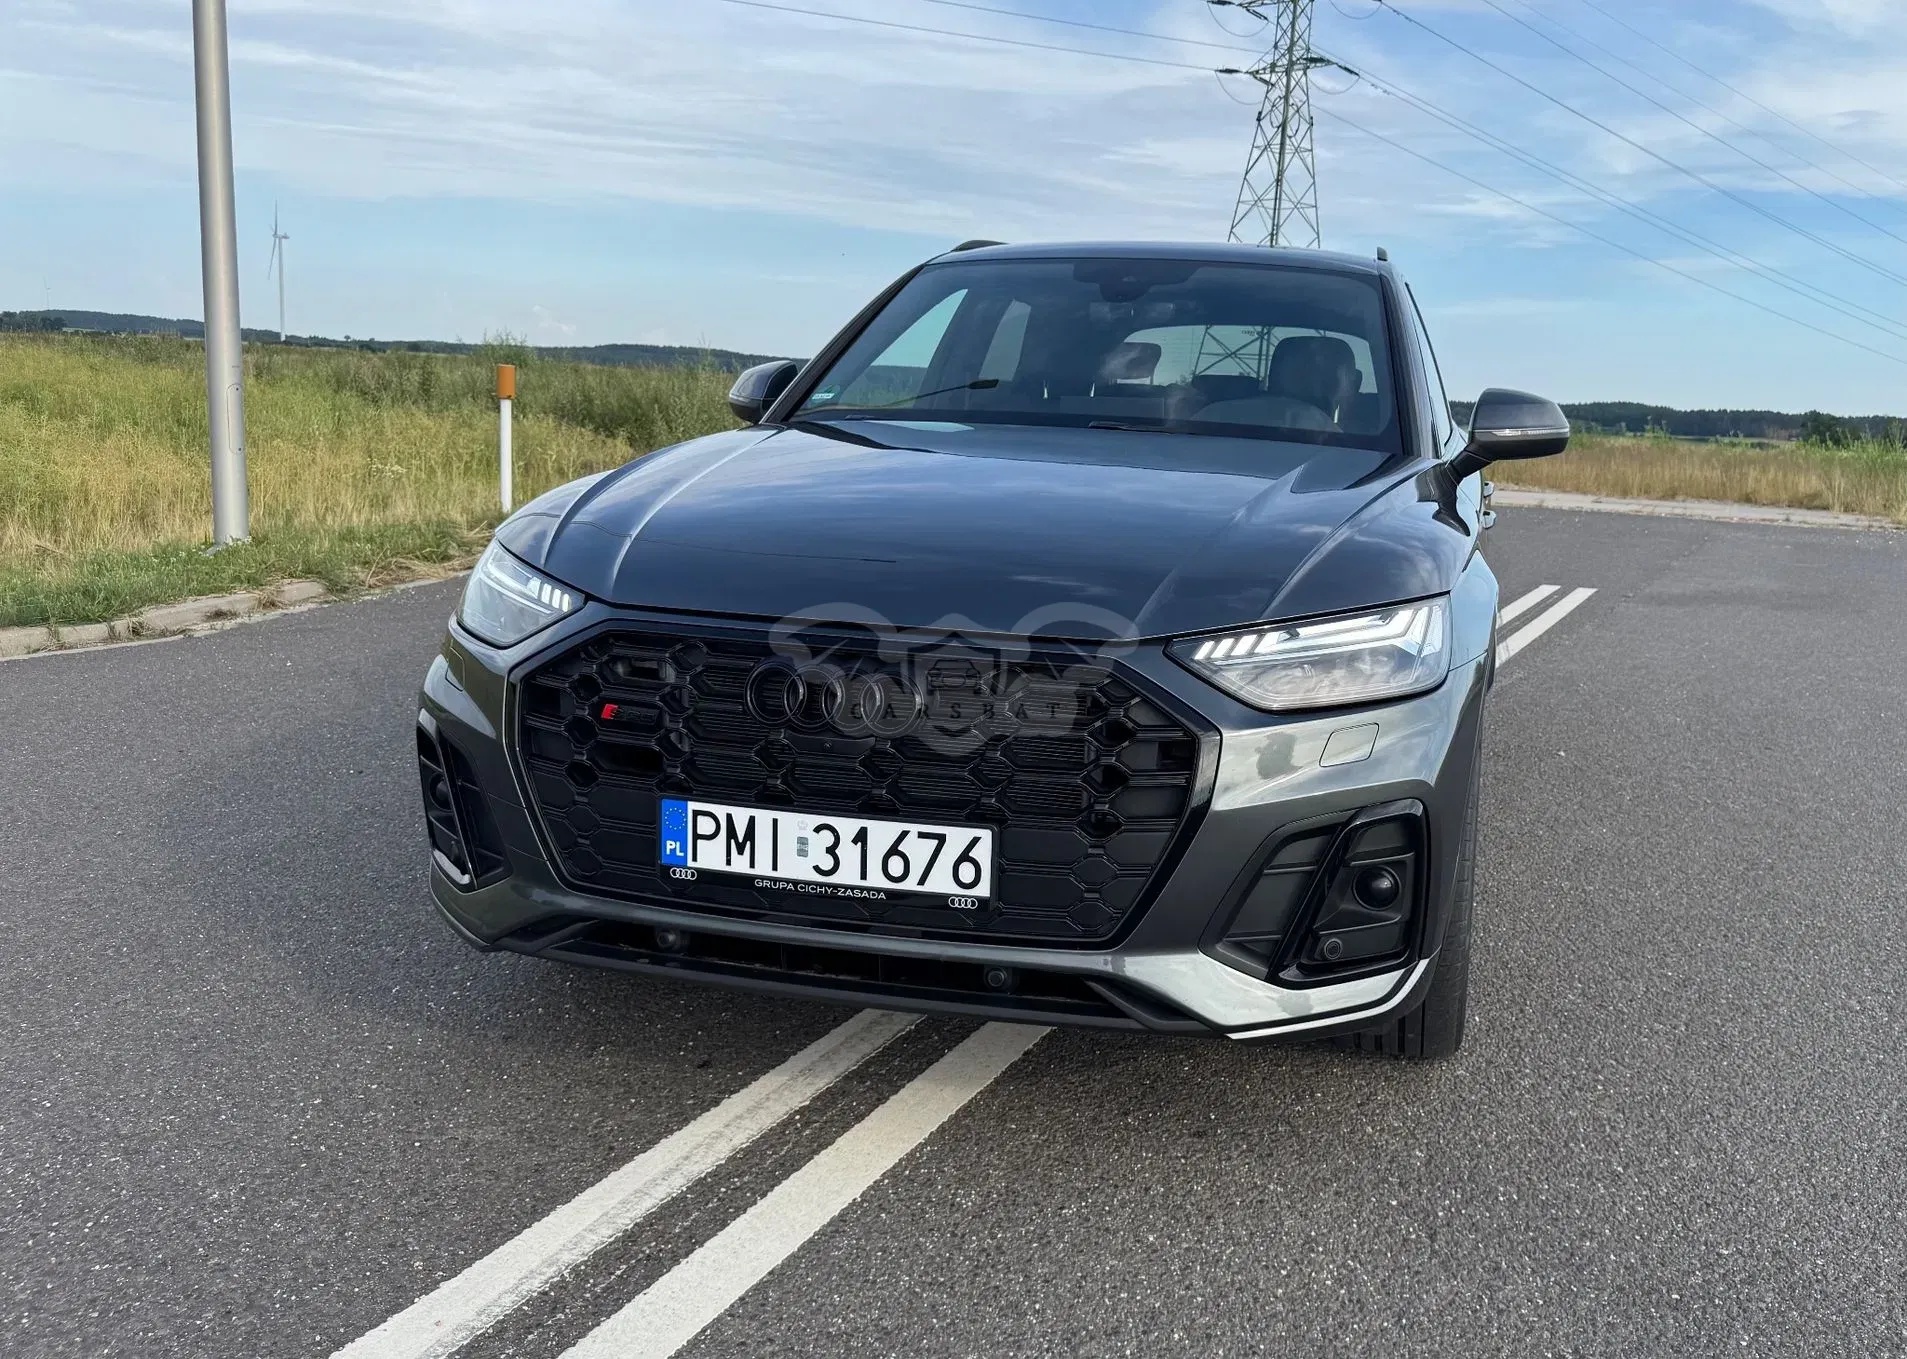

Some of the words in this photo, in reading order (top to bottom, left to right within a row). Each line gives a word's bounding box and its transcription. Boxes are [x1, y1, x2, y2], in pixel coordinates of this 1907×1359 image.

[666, 840, 684, 857] PL
[691, 809, 778, 872] PMI
[812, 823, 982, 890] 31676
[754, 878, 795, 892] GRUPA
[797, 882, 887, 900] CICHY-ZASADA
